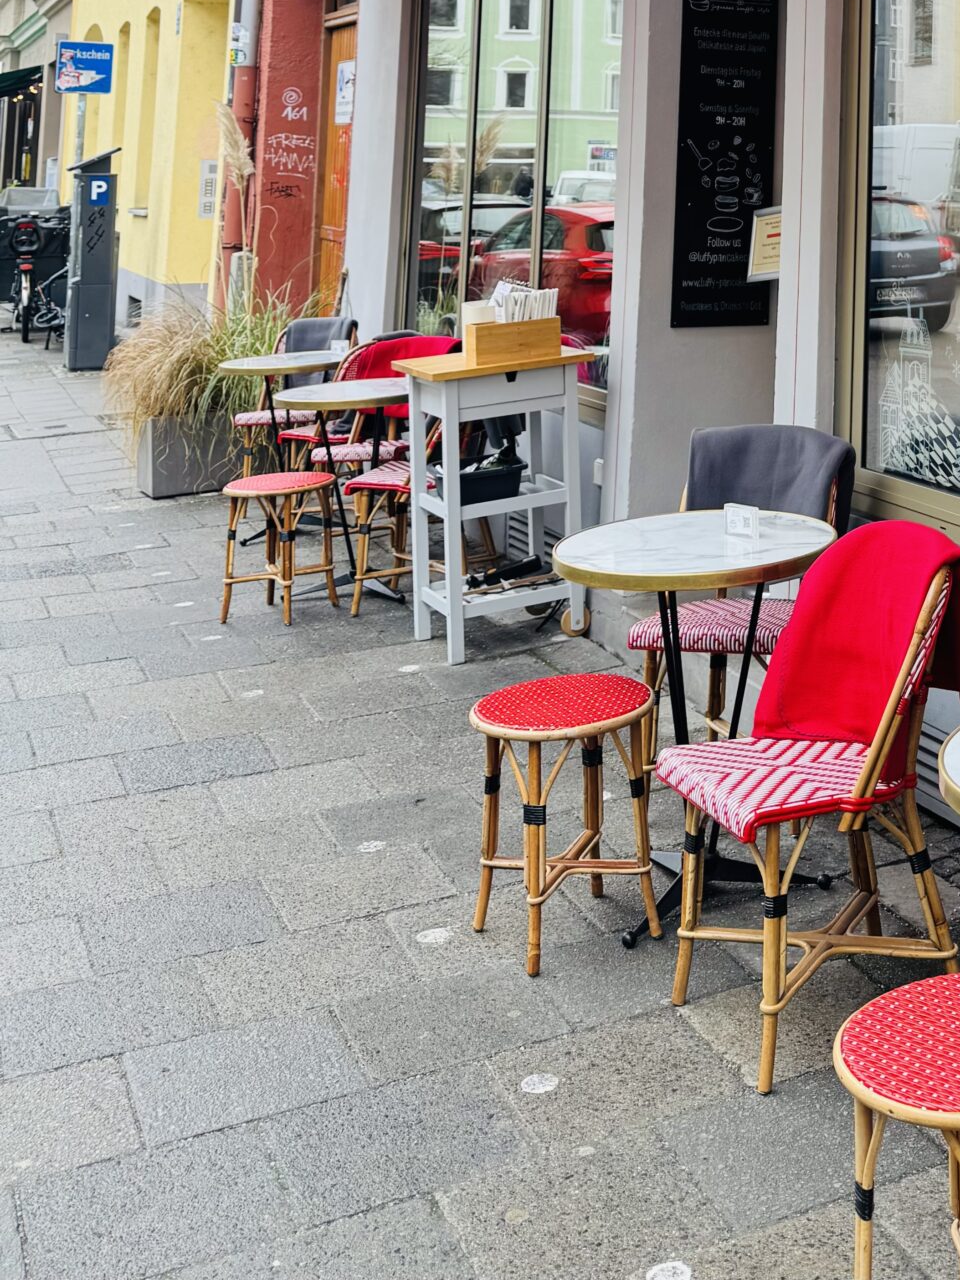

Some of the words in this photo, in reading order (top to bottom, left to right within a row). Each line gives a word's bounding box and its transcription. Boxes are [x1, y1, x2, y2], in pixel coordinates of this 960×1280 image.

[700, 65, 727, 77] Dienstag
[267, 132, 315, 149] FREE
[264, 148, 316, 172] HANNA
[91, 180, 108, 201] P
[707, 236, 731, 248] Follow
[732, 238, 742, 248] us
